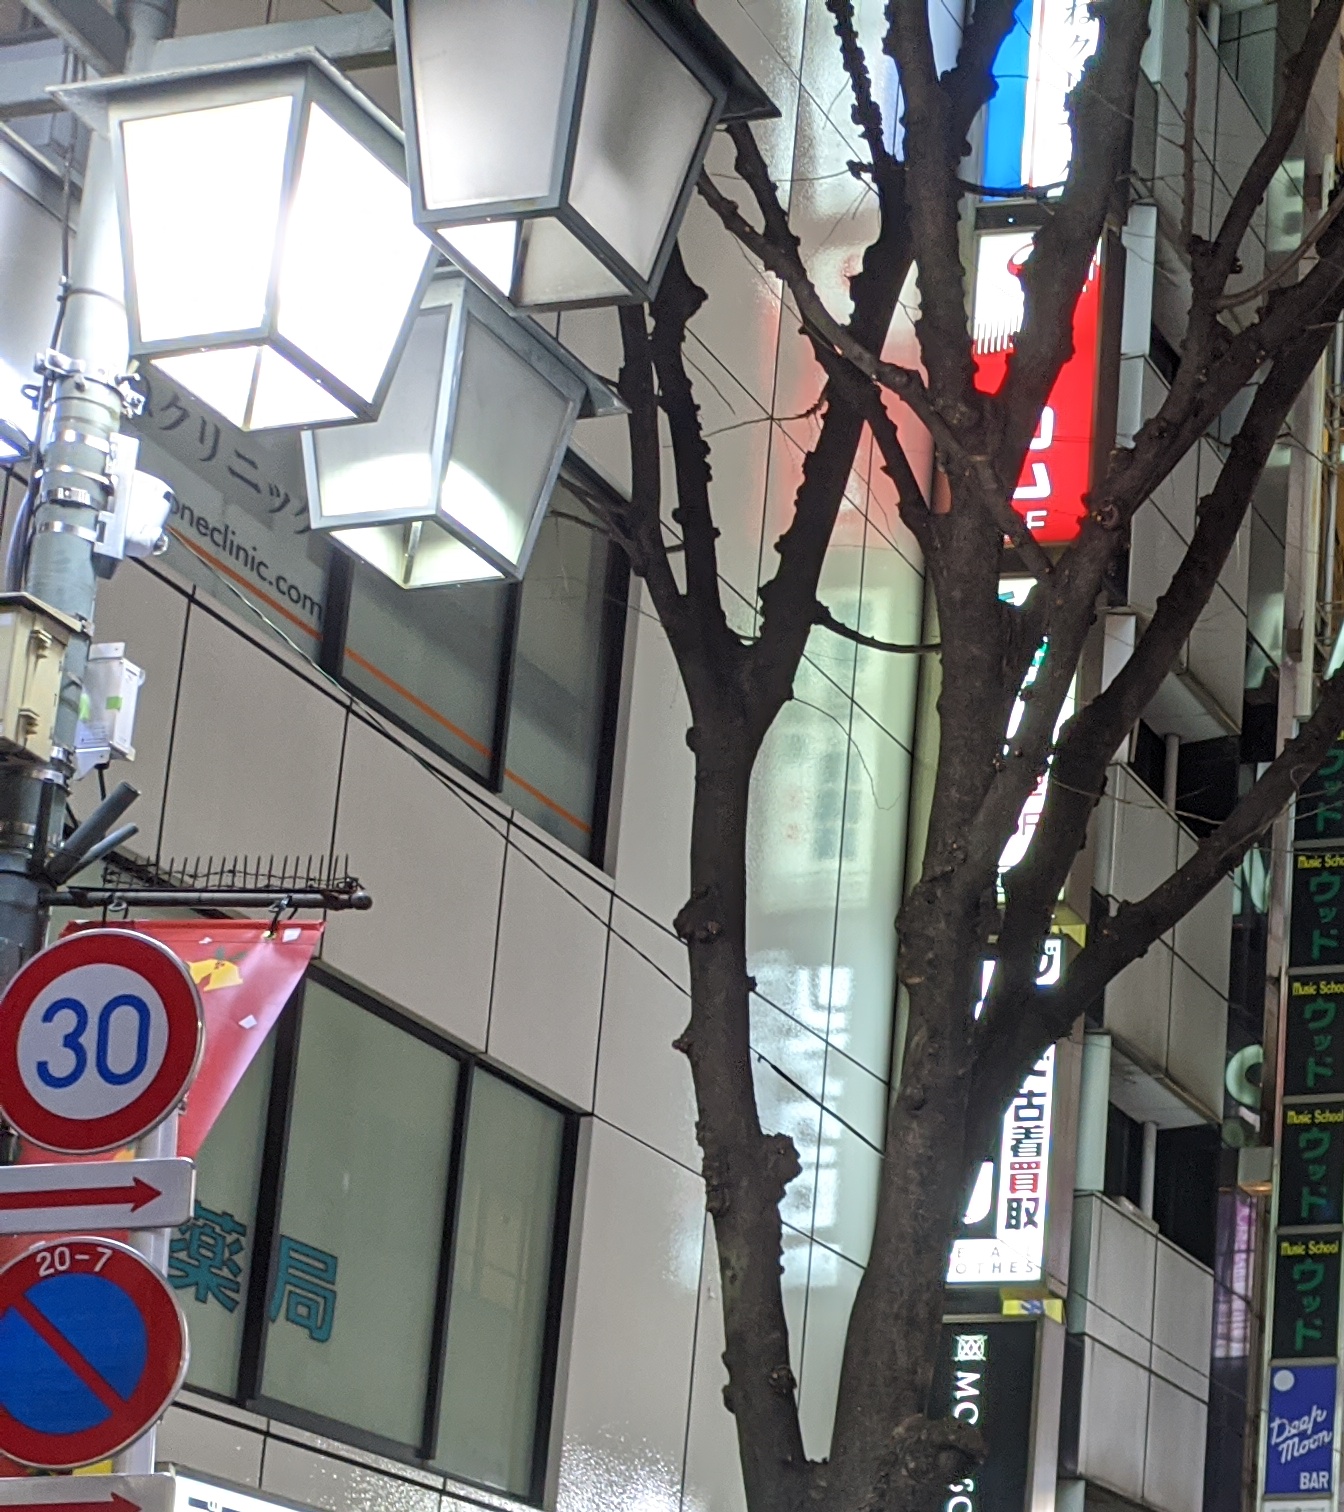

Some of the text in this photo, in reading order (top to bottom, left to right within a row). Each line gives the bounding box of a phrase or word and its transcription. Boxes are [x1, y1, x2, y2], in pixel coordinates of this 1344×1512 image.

[1298, 853, 1324, 870] Music
[1309, 868, 1342, 959] ウッド
[1292, 981, 1318, 996] Music
[36, 993, 151, 1090] 30
[1304, 995, 1337, 1087] ウッド
[1287, 1108, 1344, 1125] Music School
[1004, 1089, 1046, 1231] 古着買取
[1299, 1125, 1332, 1217] ウッド
[35, 1246, 114, 1278] 20-7
[1281, 1240, 1339, 1256] Music School
[168, 1200, 339, 1344] 薬局
[1292, 1257, 1326, 1351] ウッド
[1270, 1405, 1327, 1446] Deep
[1278, 1427, 1332, 1464] Moon
[1299, 1470, 1330, 1490] BAR
